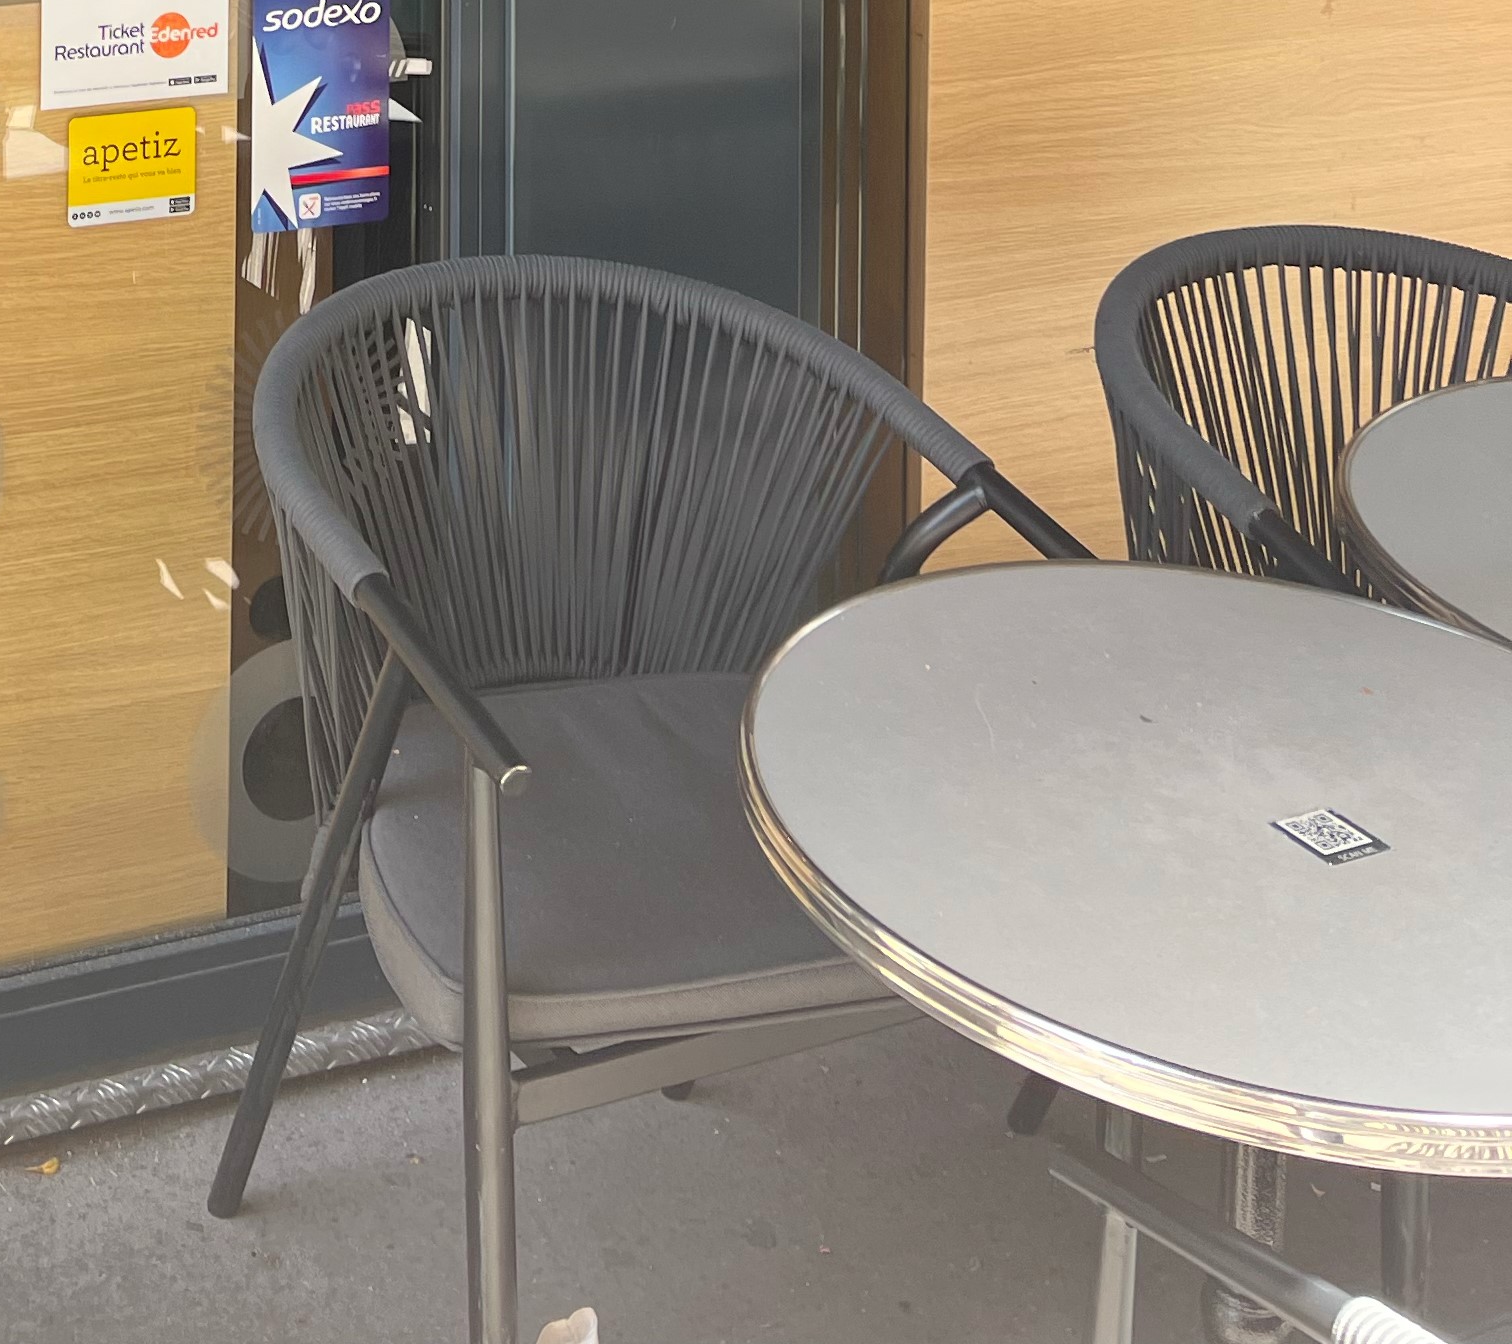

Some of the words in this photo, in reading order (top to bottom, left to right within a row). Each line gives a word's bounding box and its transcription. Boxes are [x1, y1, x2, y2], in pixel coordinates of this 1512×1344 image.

[97, 22, 145, 40] Ticket
[150, 22, 219, 43] Edenred
[54, 41, 145, 61] Restaurant
[310, 113, 380, 135] RESTAURANT
[83, 131, 181, 172] apetiz
